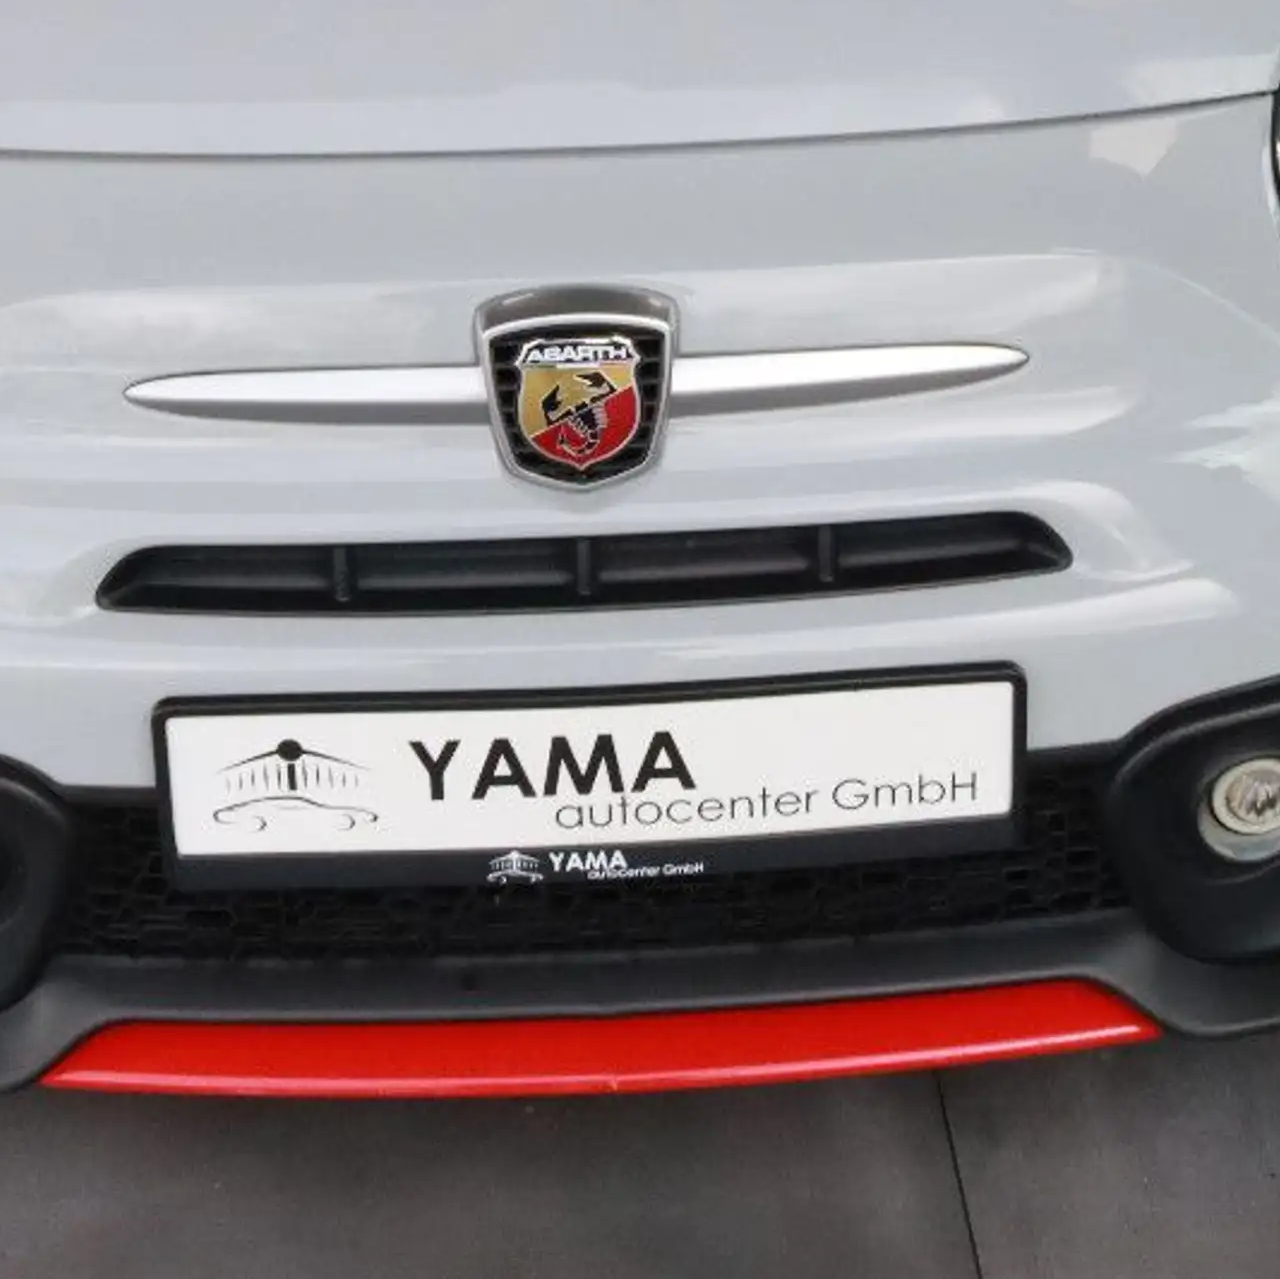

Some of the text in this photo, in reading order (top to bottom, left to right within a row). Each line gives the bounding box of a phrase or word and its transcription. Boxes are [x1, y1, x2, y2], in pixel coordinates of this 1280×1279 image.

[526, 344, 628, 363] ABARTH
[408, 730, 697, 801] YAMA
[555, 771, 978, 829] autocenter GmbH
[548, 848, 629, 872] YAMA
[661, 861, 705, 877] GmbH
